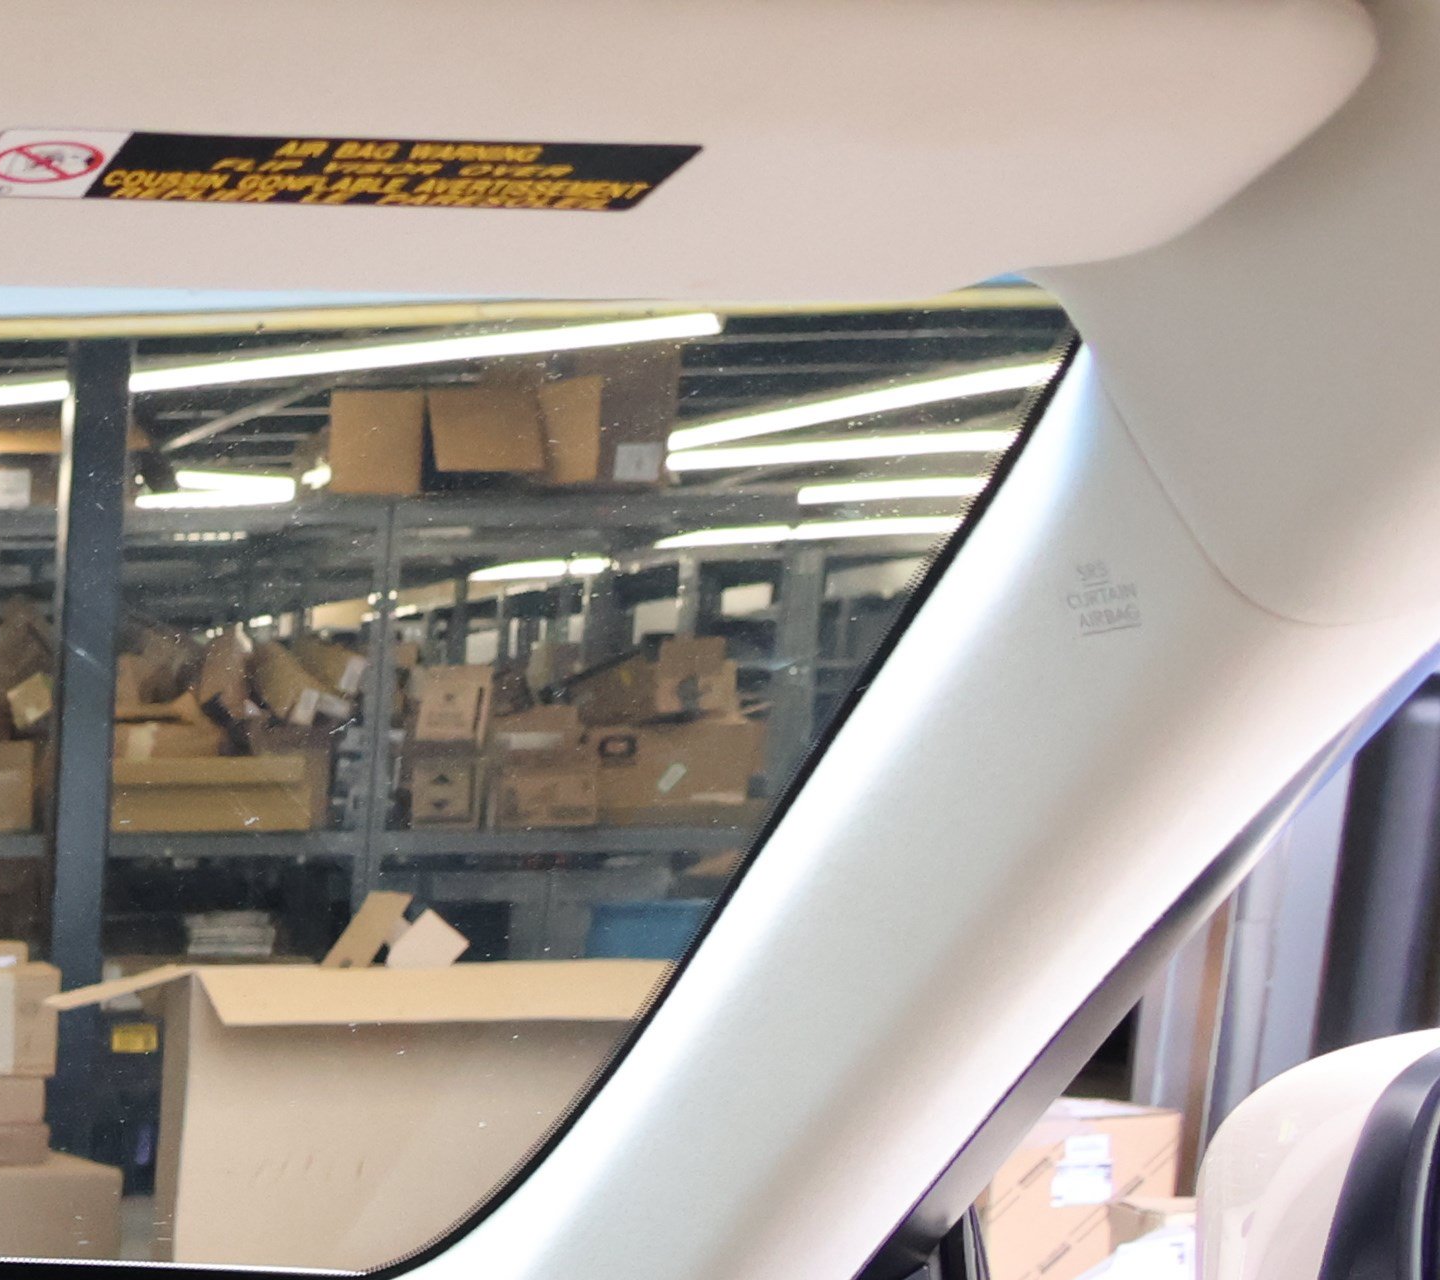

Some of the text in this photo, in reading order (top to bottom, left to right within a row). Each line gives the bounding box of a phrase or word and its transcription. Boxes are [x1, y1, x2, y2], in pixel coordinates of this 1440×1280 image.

[275, 140, 544, 163] AIR BAG WARNING
[457, 164, 575, 177] OVER
[102, 169, 654, 201] COUSSIN GONFLABLE AVERTISSEMENT
[1080, 605, 1140, 629] AIRBAG
